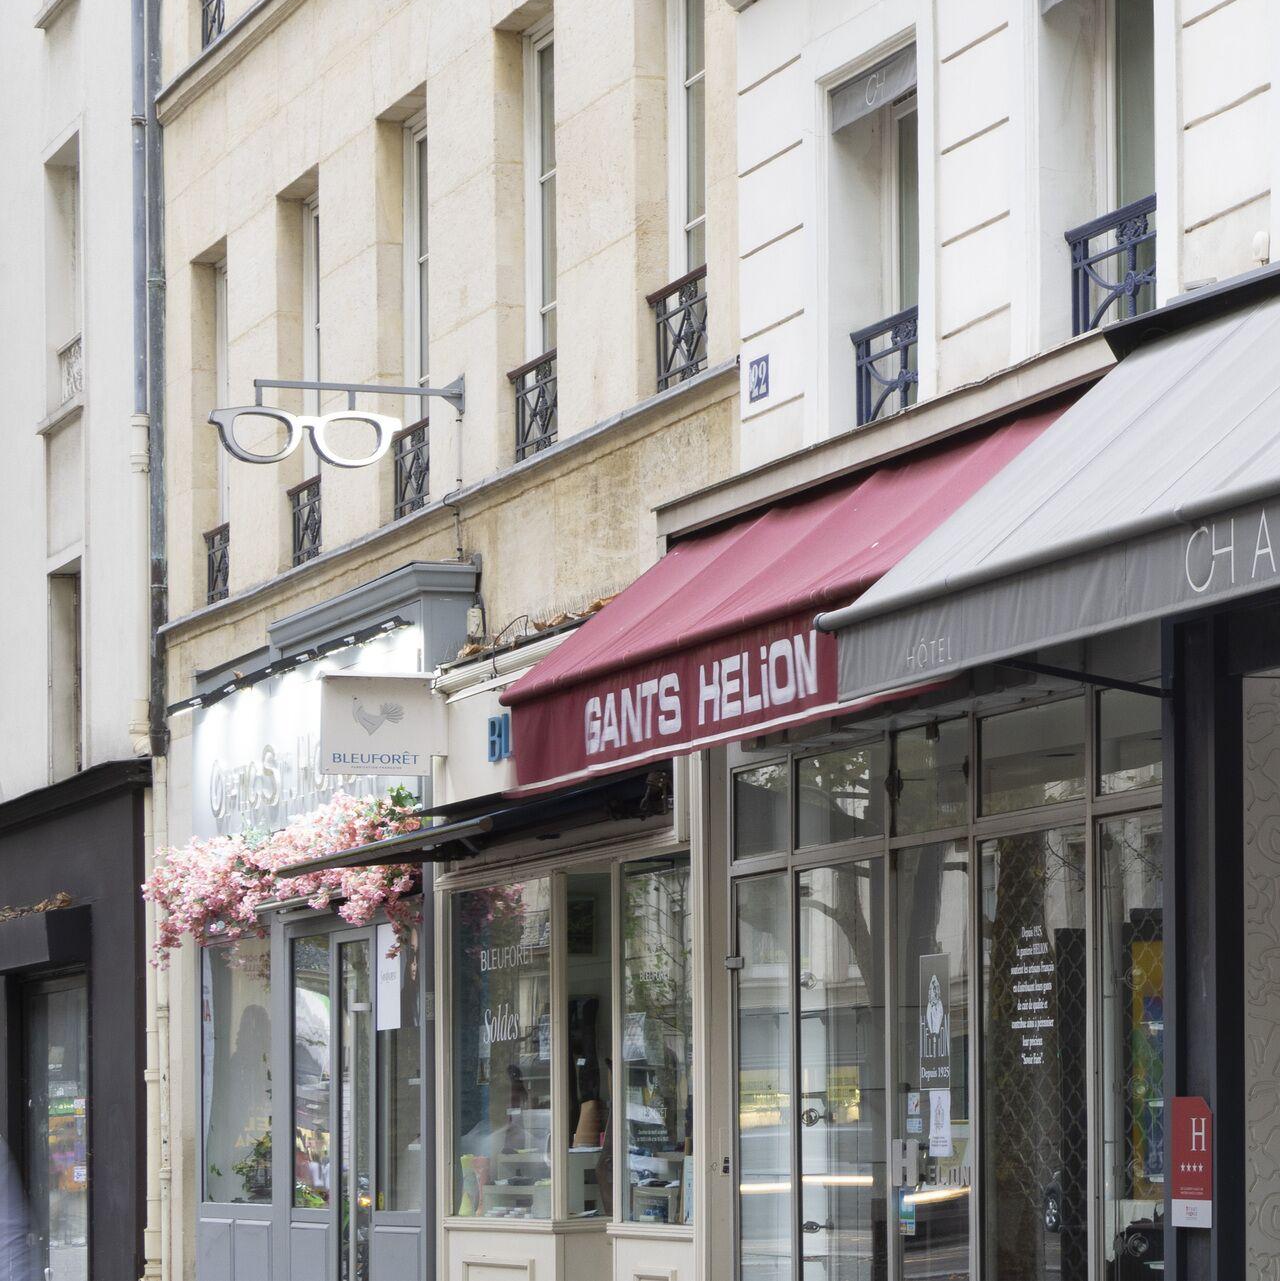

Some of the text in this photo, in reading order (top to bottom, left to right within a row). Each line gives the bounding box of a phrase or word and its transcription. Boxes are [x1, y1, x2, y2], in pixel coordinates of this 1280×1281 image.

[751, 360, 767, 399] 22
[906, 636, 952, 670] HÔTEL
[584, 672, 682, 756] GANTS
[332, 750, 420, 765] BLEUFORÊT
[484, 1003, 520, 1044] Soldes
[921, 1066, 950, 1081] Depuis 1925
[1190, 1117, 1207, 1152] H
